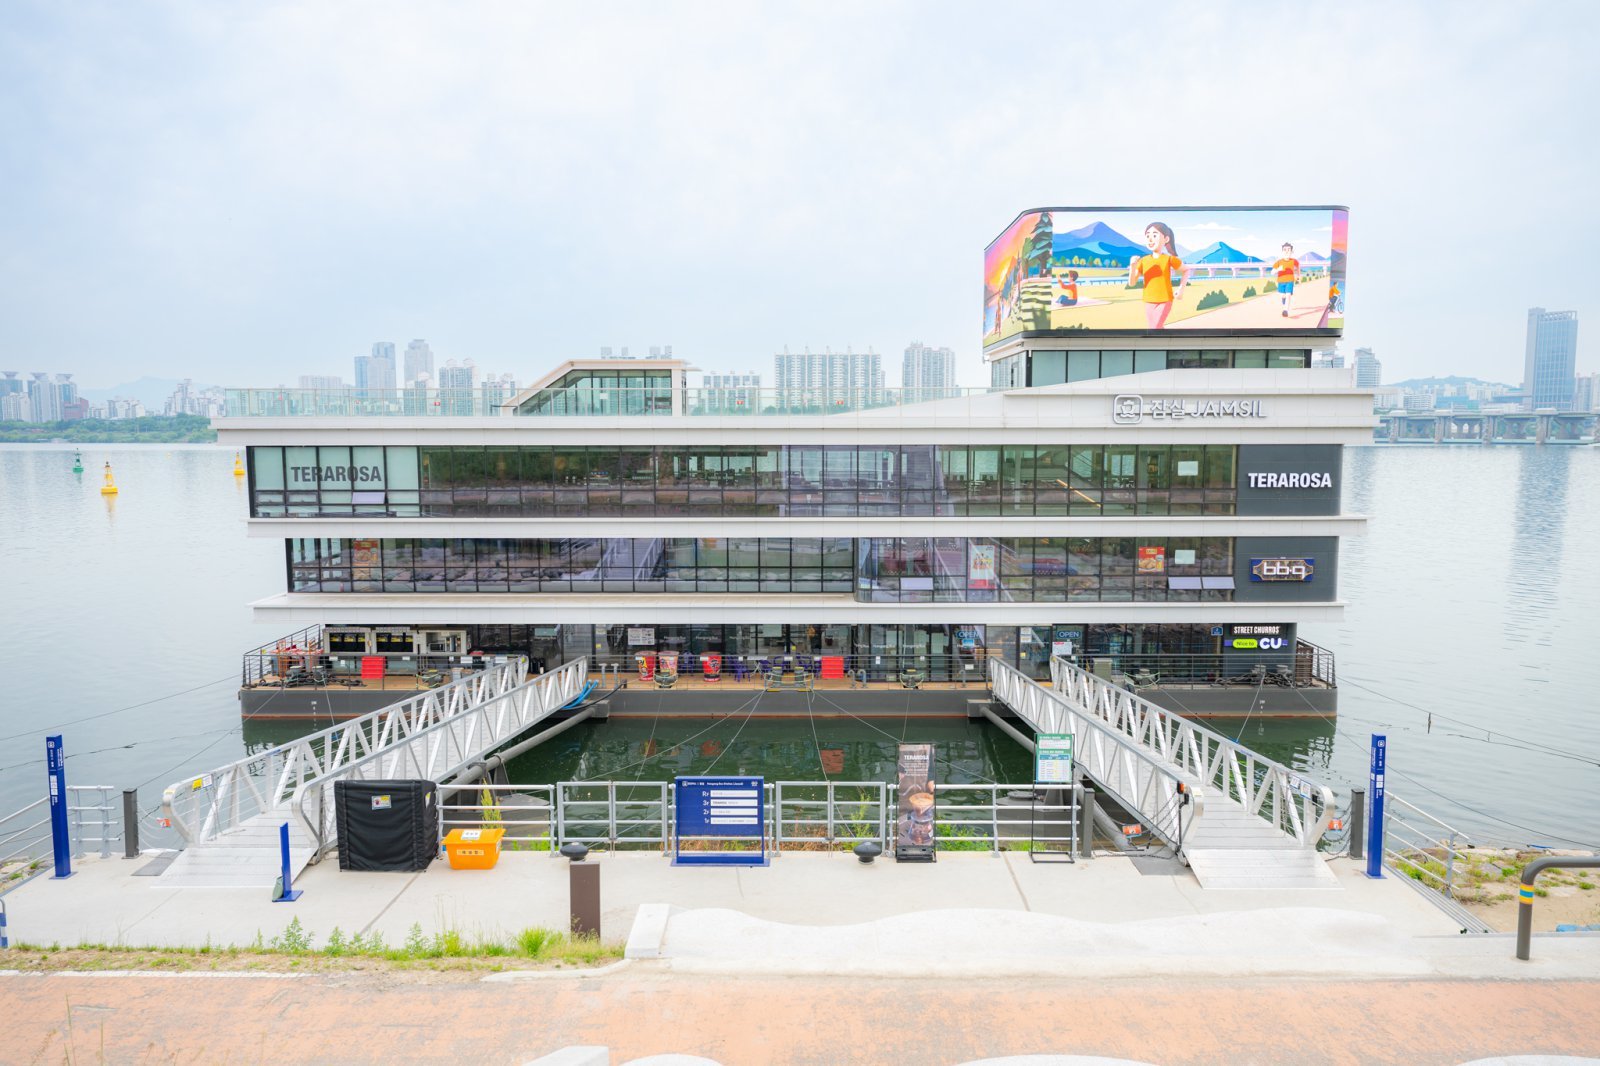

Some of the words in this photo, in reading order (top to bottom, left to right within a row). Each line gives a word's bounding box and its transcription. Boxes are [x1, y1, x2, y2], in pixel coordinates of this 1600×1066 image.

[1150, 399, 1185, 419] 잠실
[1191, 399, 1267, 418] JAMSIL
[291, 466, 382, 482] TERAROSA
[1248, 472, 1332, 488] TERAROSA
[1234, 626, 1253, 634] STREET
[1254, 626, 1279, 634] CHURROS
[1260, 637, 1282, 649] CU
